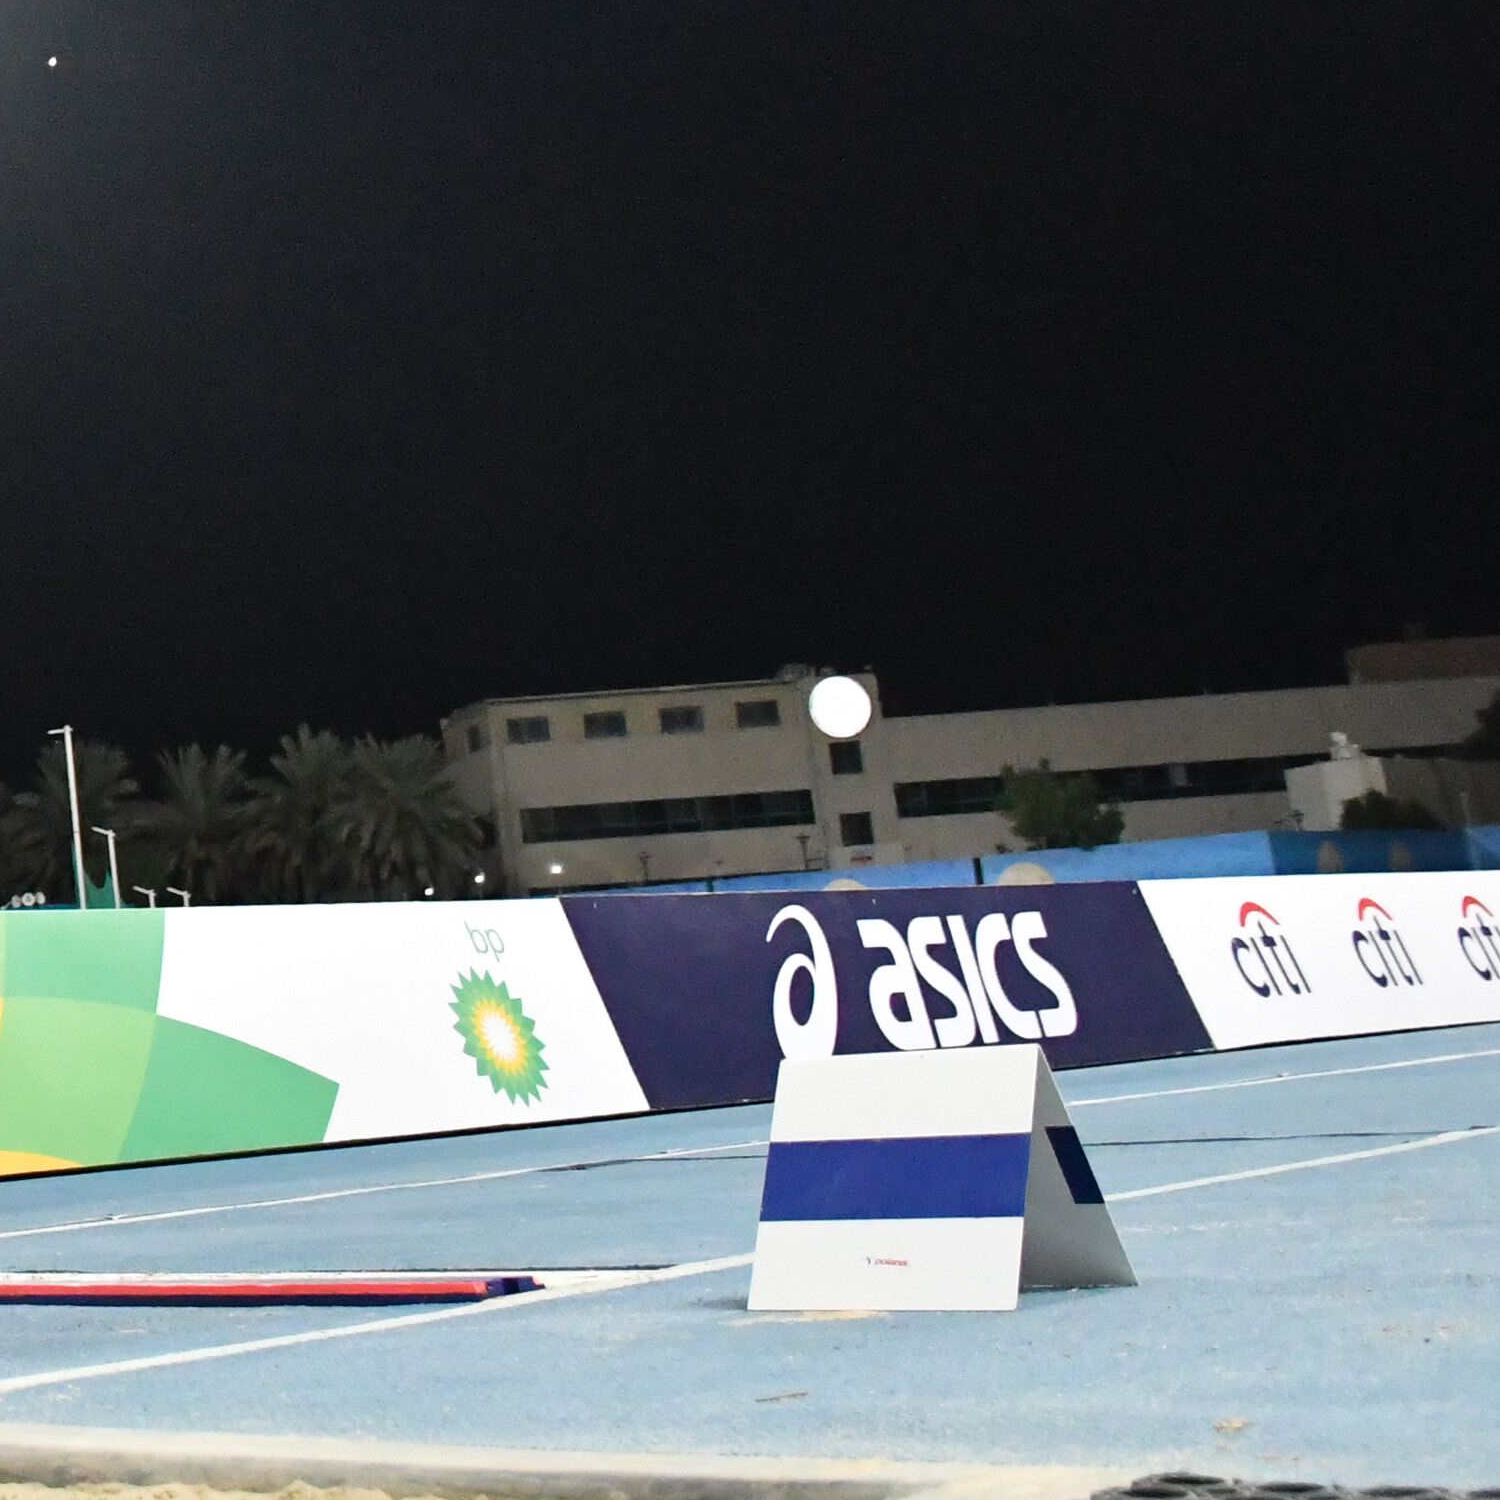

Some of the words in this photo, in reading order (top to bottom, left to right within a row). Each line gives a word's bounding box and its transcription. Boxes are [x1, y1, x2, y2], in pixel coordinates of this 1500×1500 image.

[464, 921, 504, 963] bp
[1231, 915, 1311, 998] citi
[1352, 912, 1423, 988] citi
[1457, 911, 1500, 981] cit
